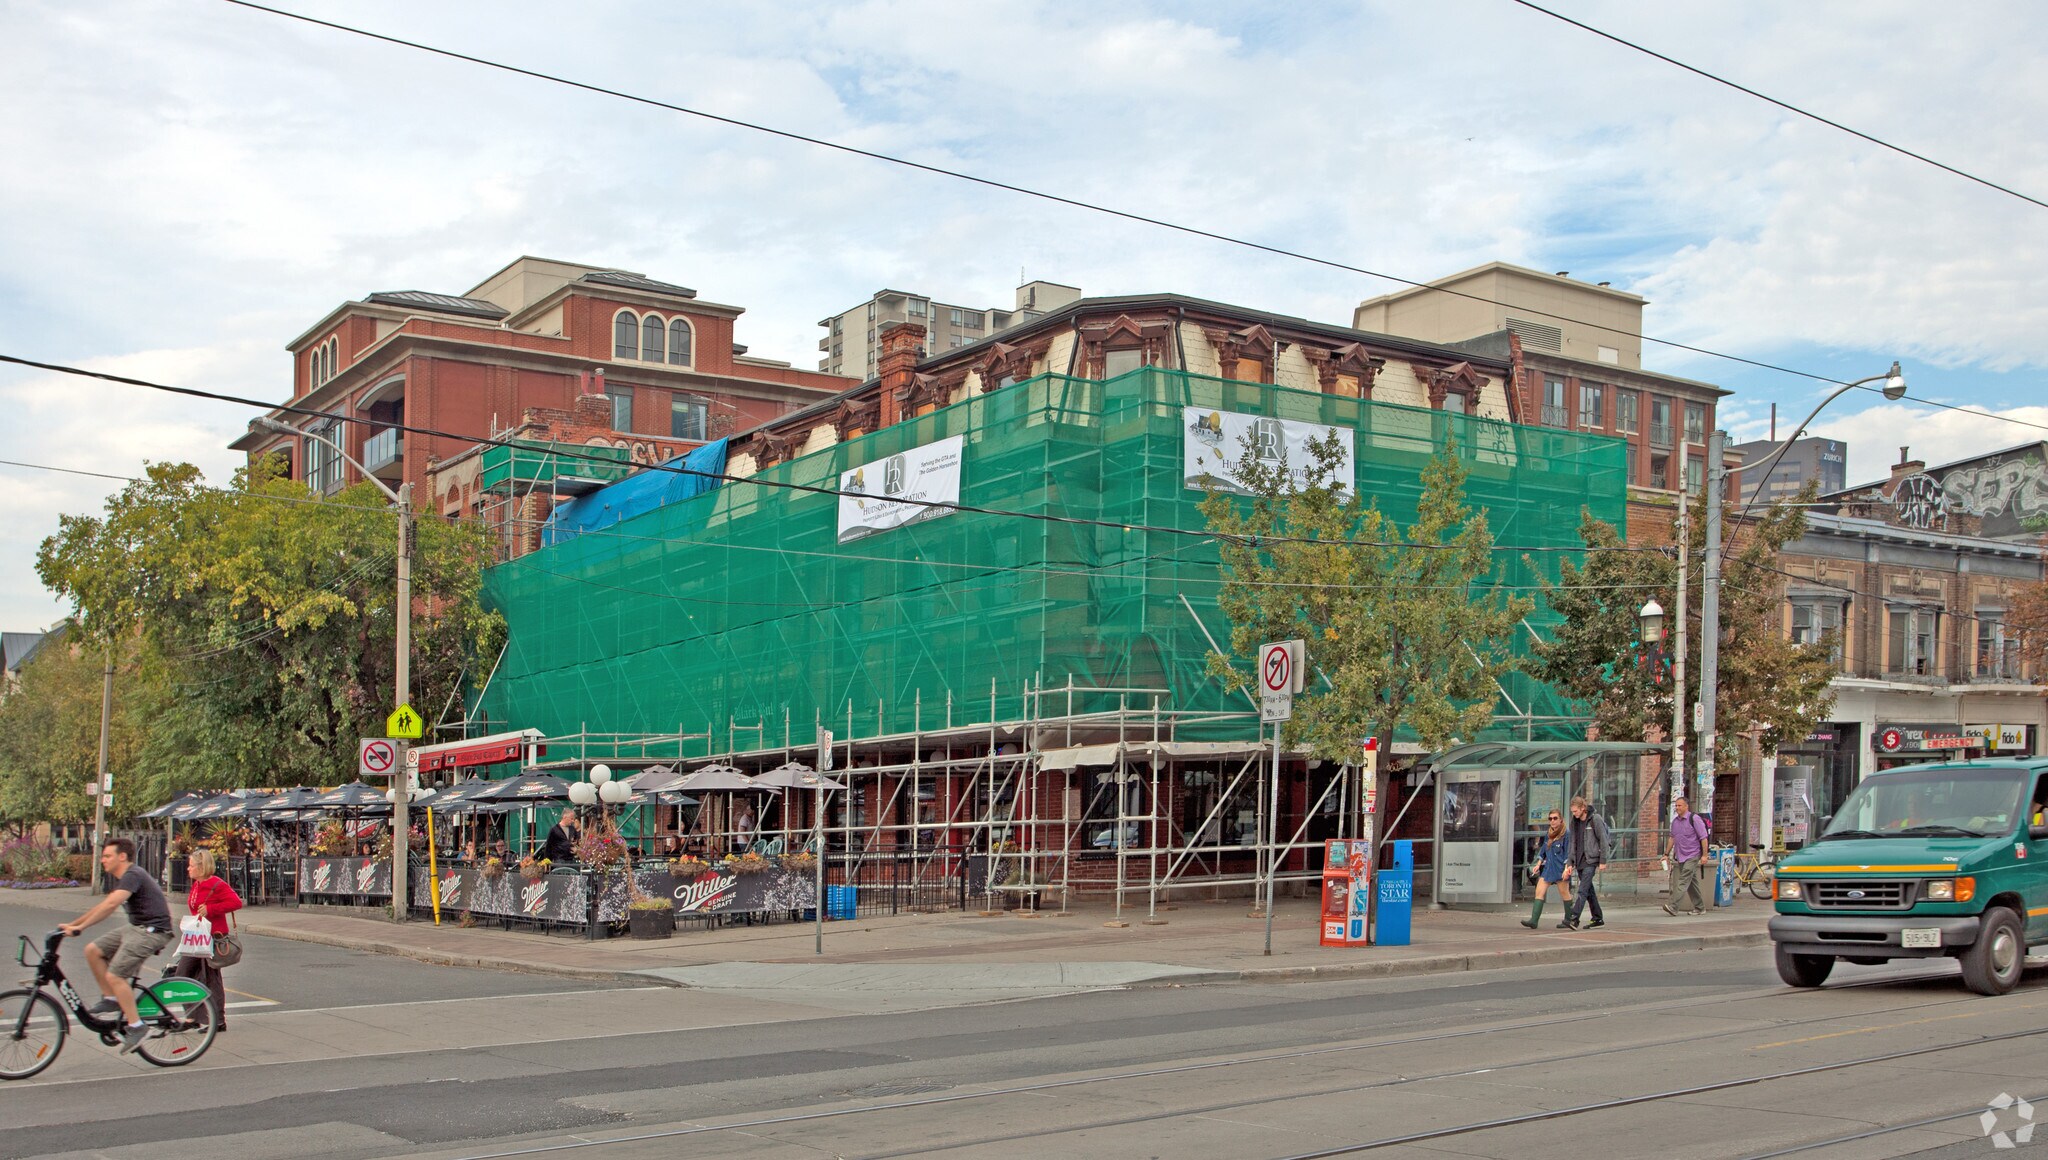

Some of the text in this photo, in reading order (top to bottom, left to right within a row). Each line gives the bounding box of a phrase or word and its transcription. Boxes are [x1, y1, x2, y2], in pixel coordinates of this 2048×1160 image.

[920, 459, 935, 468] Serving
[1823, 453, 1842, 463] ZURICH
[863, 501, 889, 517] HUDSON
[1927, 738, 1975, 749] EMERGENCY
[2002, 732, 2015, 744] fido
[521, 880, 549, 911] Miller
[674, 873, 738, 912] Miller
[1380, 888, 1409, 899] STAR
[707, 891, 737, 907] GENUINE
[712, 899, 733, 911] DRAFT
[184, 933, 211, 945] HMV
